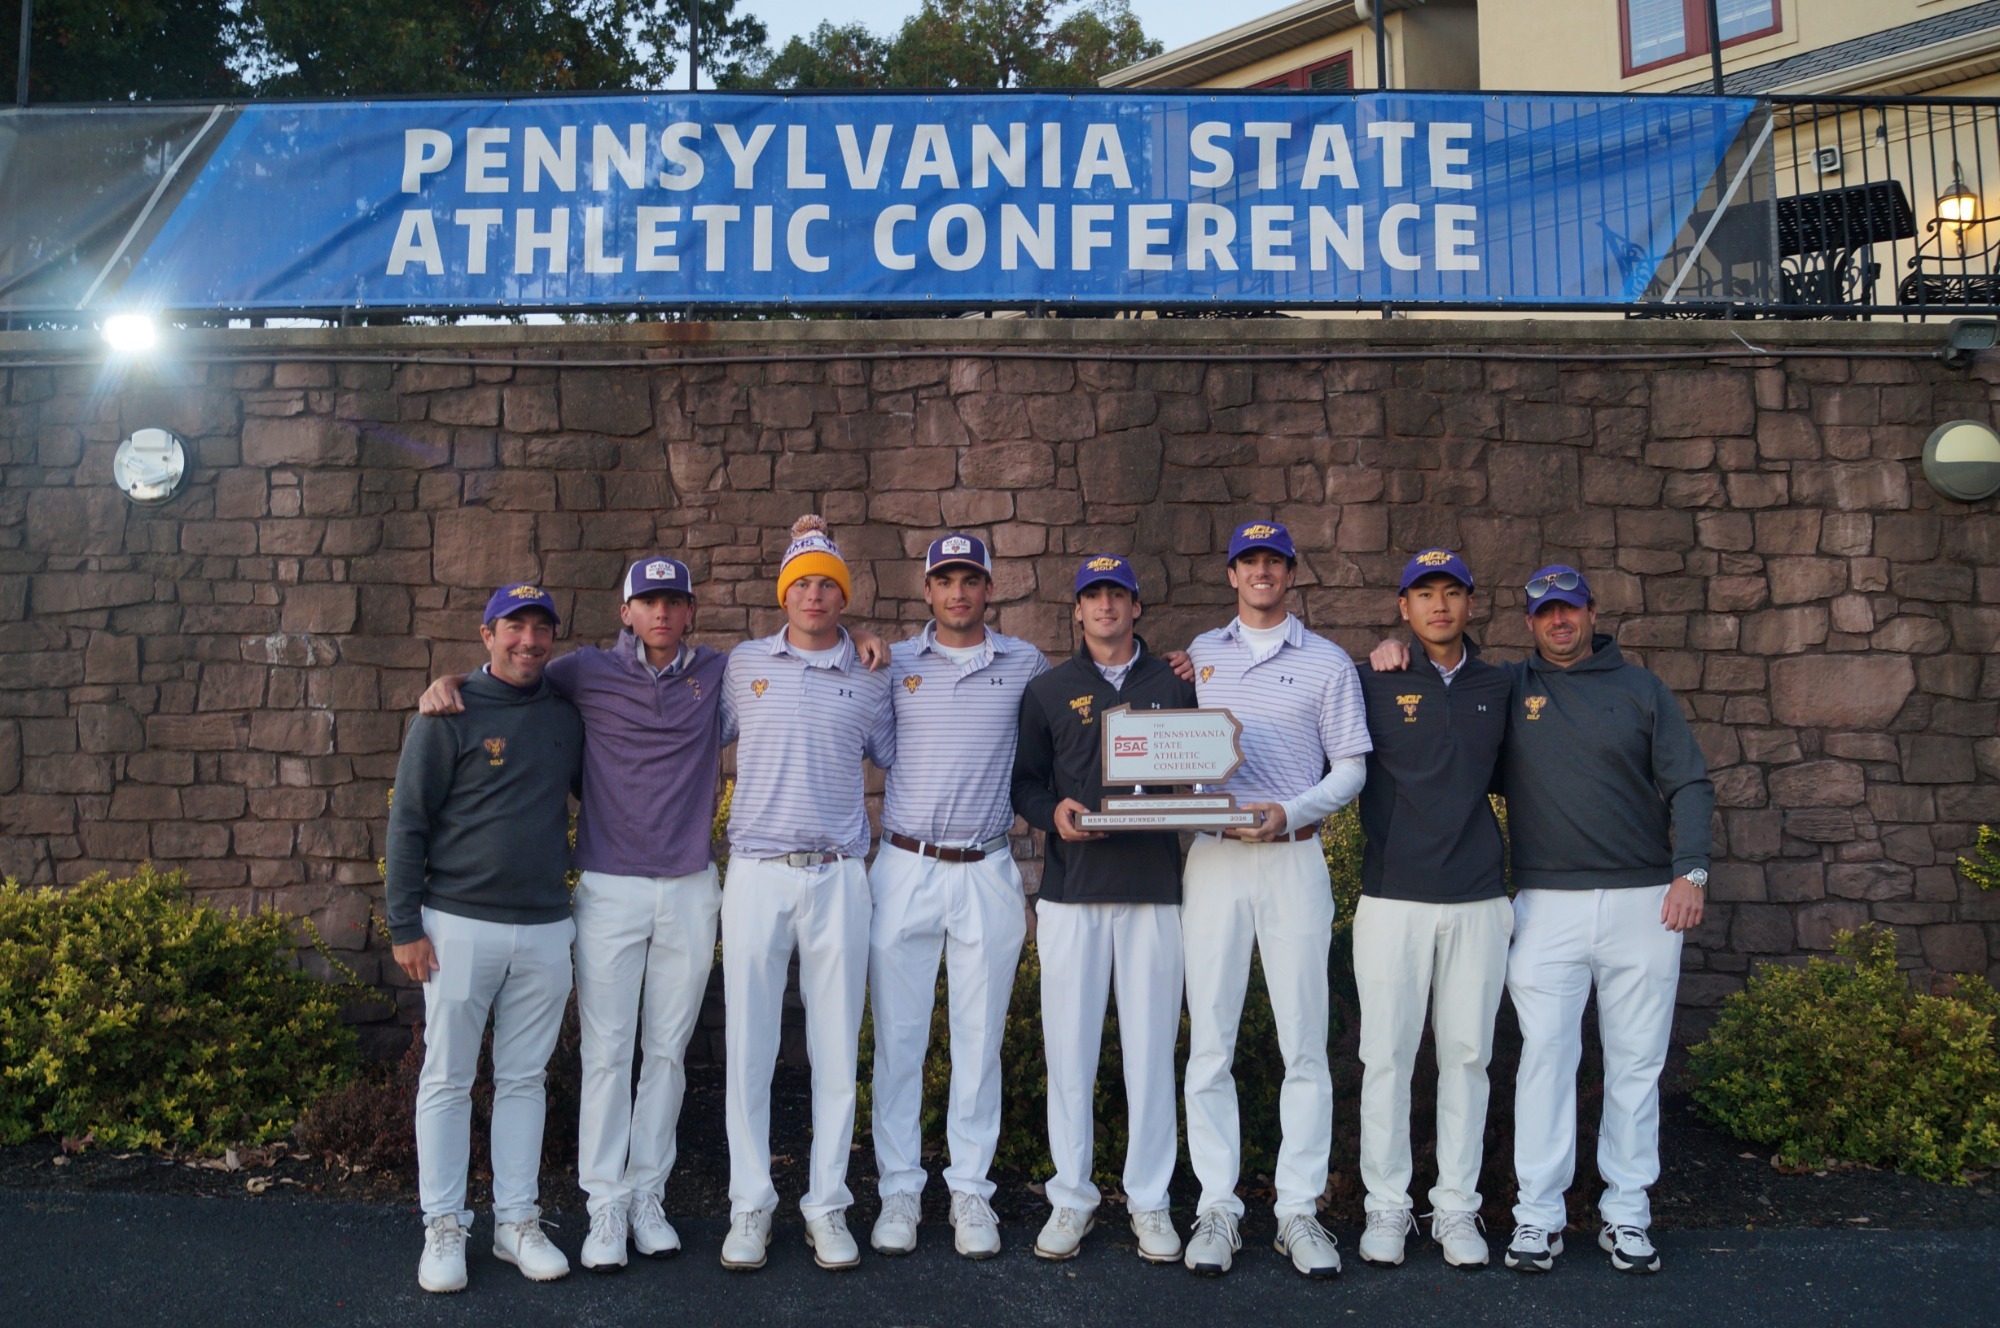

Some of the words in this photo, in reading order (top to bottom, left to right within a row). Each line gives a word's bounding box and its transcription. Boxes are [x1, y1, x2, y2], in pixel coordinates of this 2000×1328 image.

[401, 122, 1133, 194] PENNSYLVANIA
[1189, 121, 1473, 190] STATE
[386, 204, 830, 275] ATHLETIC
[873, 203, 1480, 271] CONFERENCE
[1153, 730, 1226, 738] PENNSYLVANIA
[1114, 742, 1148, 751] PSAC
[1153, 741, 1182, 749] STATE
[1153, 751, 1200, 760] ATHLETIC
[1153, 762, 1217, 770] CONFERENCE
